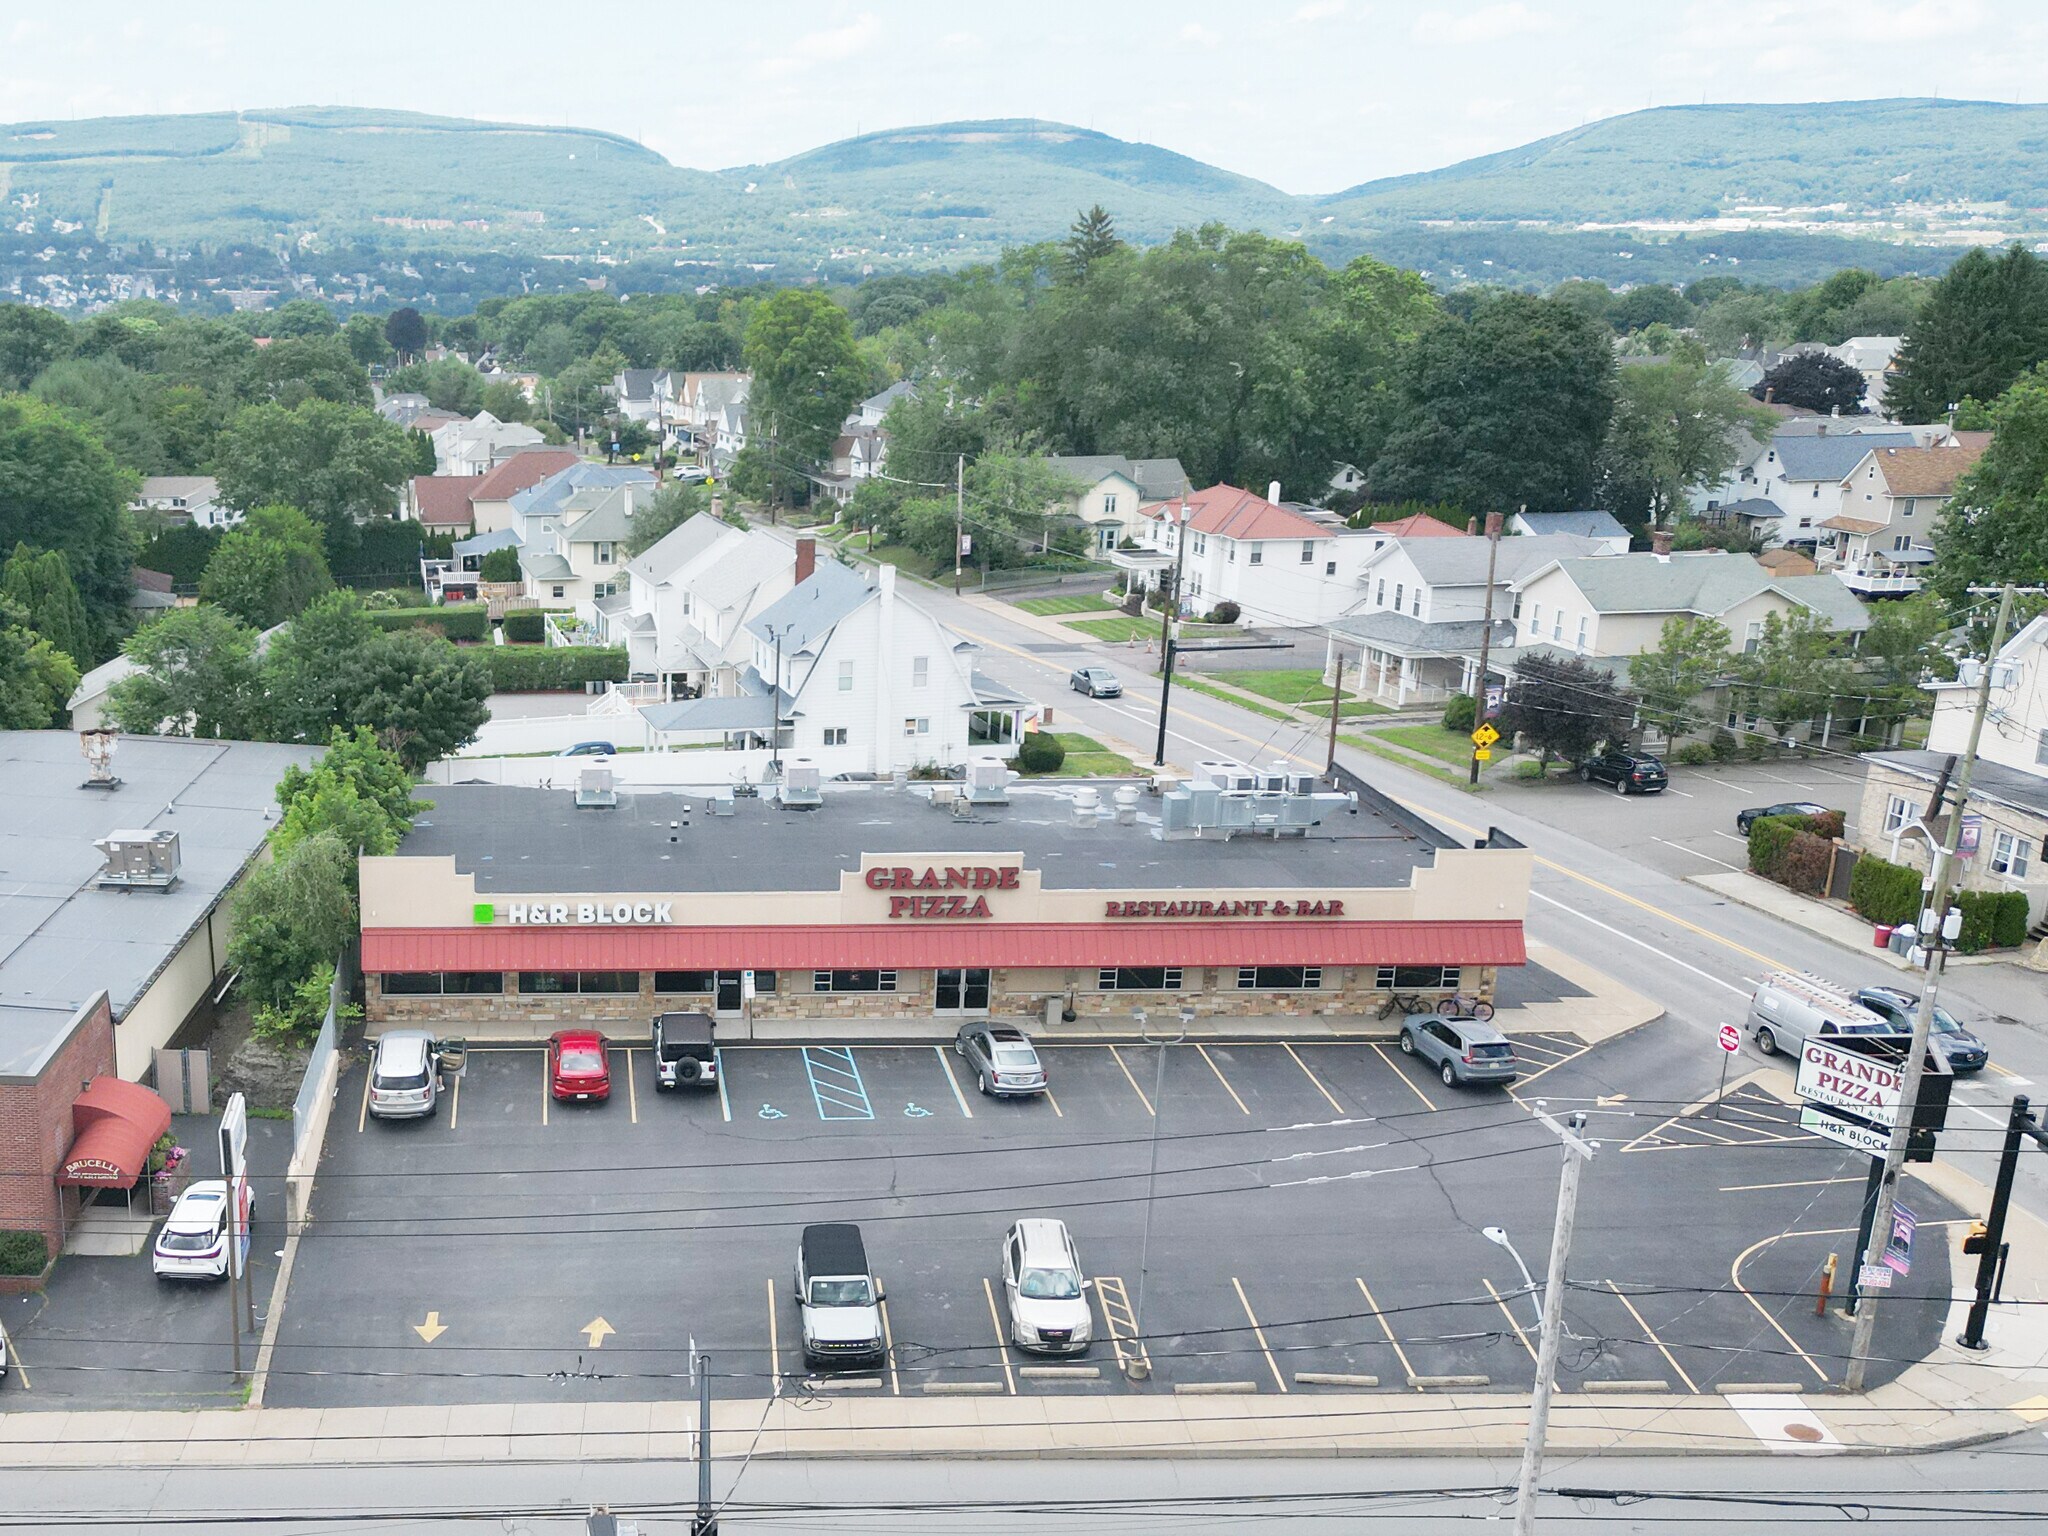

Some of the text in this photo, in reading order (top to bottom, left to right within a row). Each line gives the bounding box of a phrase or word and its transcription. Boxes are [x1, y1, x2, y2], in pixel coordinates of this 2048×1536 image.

[865, 867, 1020, 890] GRANDE
[509, 903, 673, 924] H&R BLOCK
[888, 895, 993, 918] PIZZA
[1105, 900, 1345, 917] RESTAURANT & BAR
[1816, 1071, 1883, 1107] PIZZA
[1800, 1085, 1865, 1117] RESTAURANT
[1820, 1120, 1889, 1152] H&R BLOCK
[66, 1159, 120, 1174] BRUCELLI
